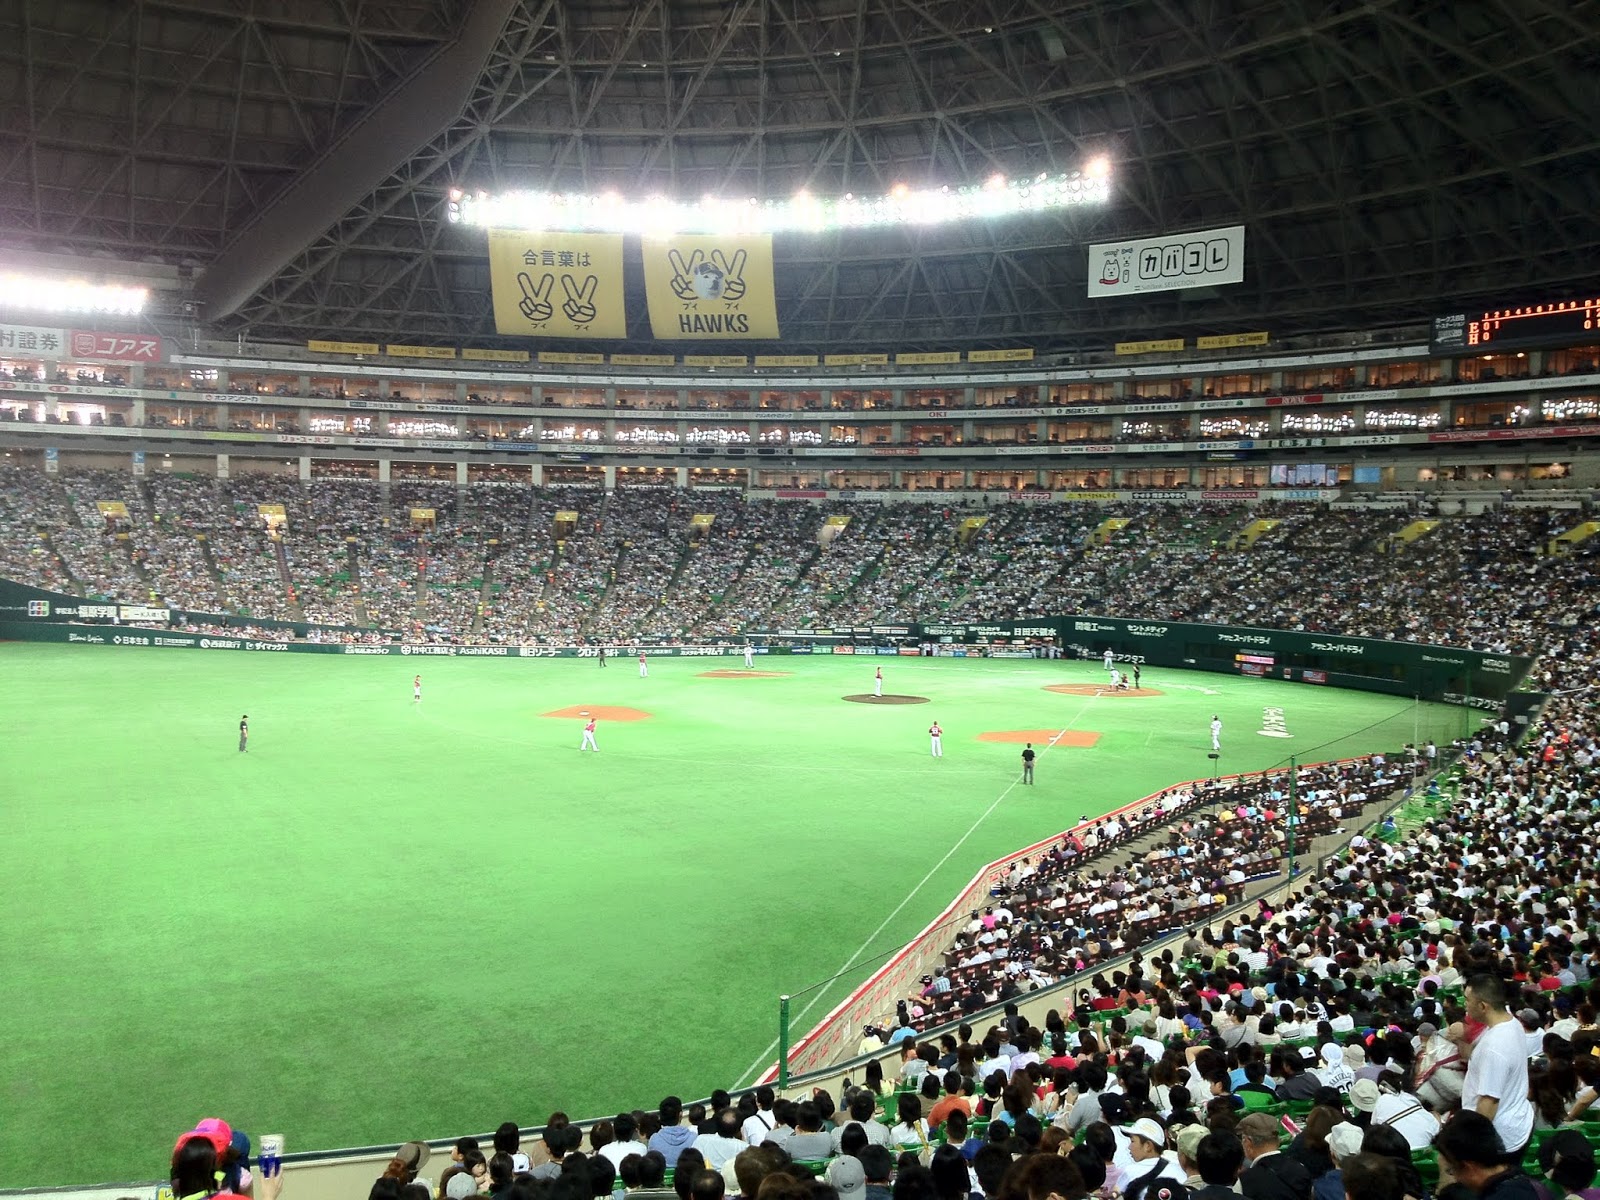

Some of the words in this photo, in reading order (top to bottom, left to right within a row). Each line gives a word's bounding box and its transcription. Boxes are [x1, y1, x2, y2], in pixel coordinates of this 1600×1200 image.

[522, 249, 591, 268] 合言葉は
[1164, 279, 1195, 288] SELECTION
[682, 303, 698, 311] ブイ
[725, 303, 740, 311] ブイ
[679, 313, 750, 333] HAWKS
[1468, 322, 1479, 333] E
[1483, 322, 1490, 331] 0
[1468, 333, 1479, 345] H
[1483, 331, 1490, 341] 0
[1014, 627, 1057, 637] 日田天領水
[1127, 624, 1168, 634] セントメディア
[1218, 633, 1271, 645] アサヒスーパードライ
[1311, 642, 1364, 654] アサヒスーパードライ
[1117, 654, 1146, 664] アクタス
